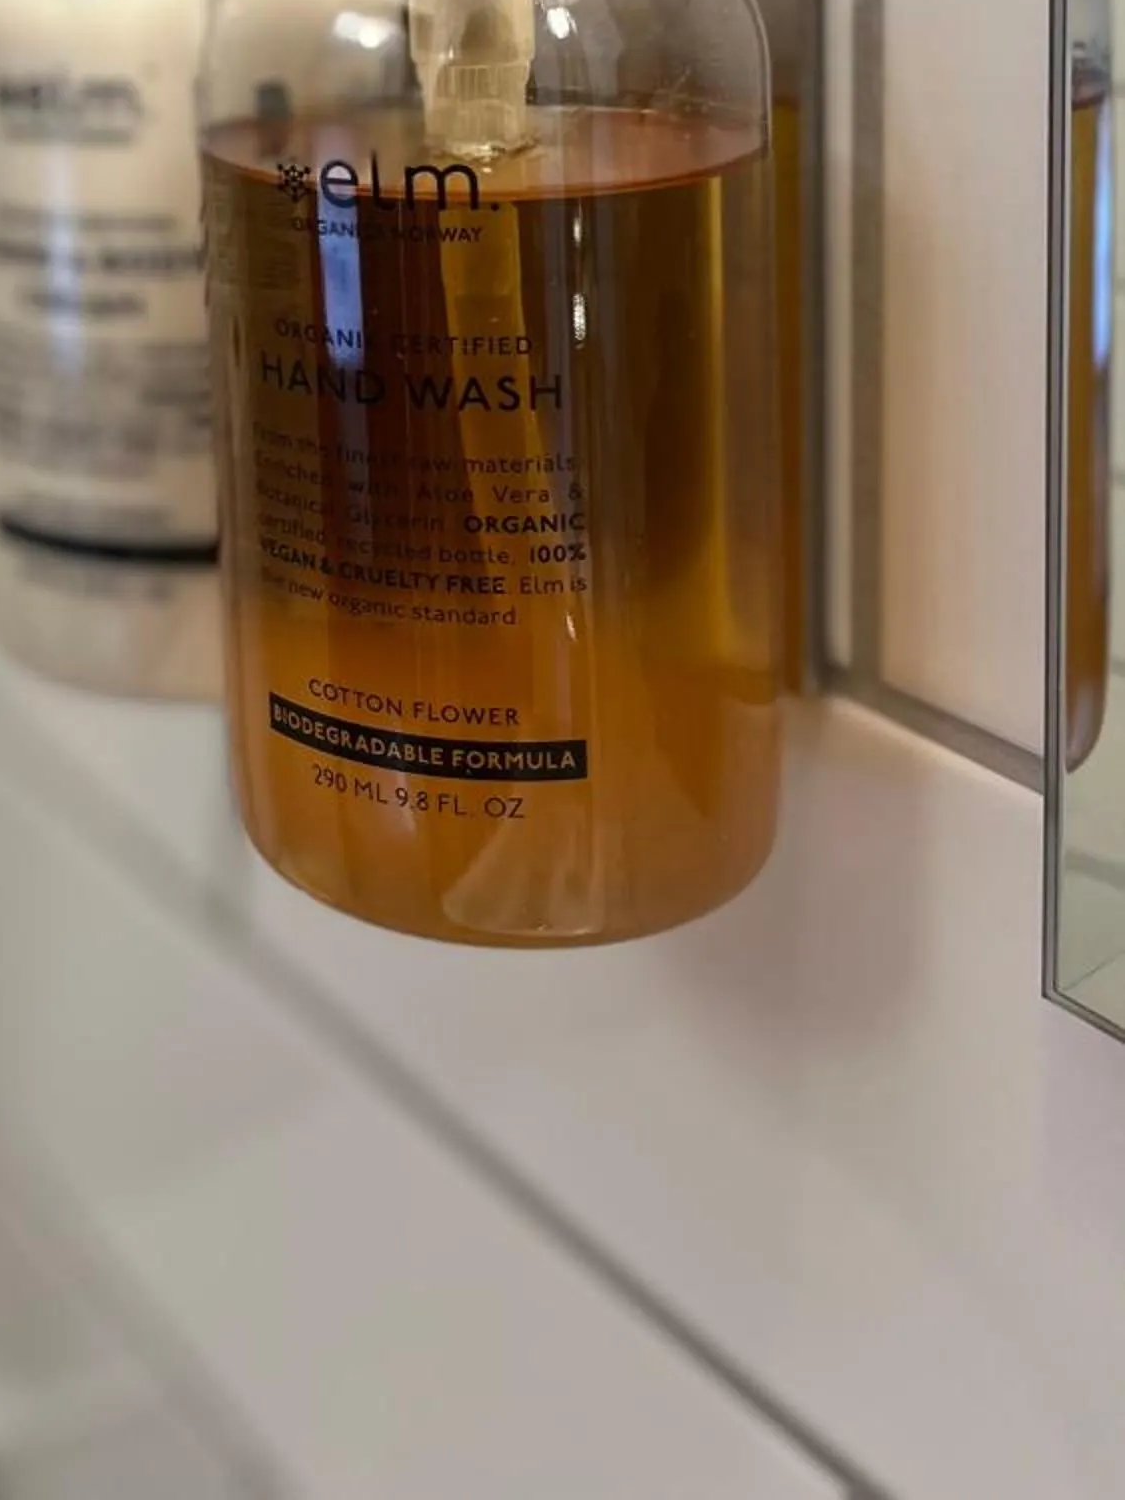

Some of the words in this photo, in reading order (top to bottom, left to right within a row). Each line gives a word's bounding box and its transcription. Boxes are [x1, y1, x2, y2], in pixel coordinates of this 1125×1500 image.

[321, 148, 500, 212] elm.
[273, 318, 376, 349] ORGANI
[389, 332, 533, 356] CERTIFIED
[261, 349, 385, 405] HAND
[404, 373, 563, 411] WASH
[417, 482, 474, 501] Aloe
[491, 483, 549, 503] Vera
[463, 512, 586, 533] ORGANIC
[529, 542, 587, 564] 100%
[320, 556, 333, 575] &
[338, 561, 440, 590] CRUELTY
[519, 574, 564, 595] Elm
[570, 575, 587, 592] is
[328, 592, 405, 618] organic
[308, 677, 403, 717] COTTON
[412, 701, 520, 726] FLOWER
[274, 703, 443, 765] BIODEGRADABLE
[452, 750, 574, 770] FORMULA
[311, 763, 348, 794] 290
[354, 776, 389, 805] ML
[394, 787, 428, 811] 9.8
[483, 796, 527, 819] OZ
